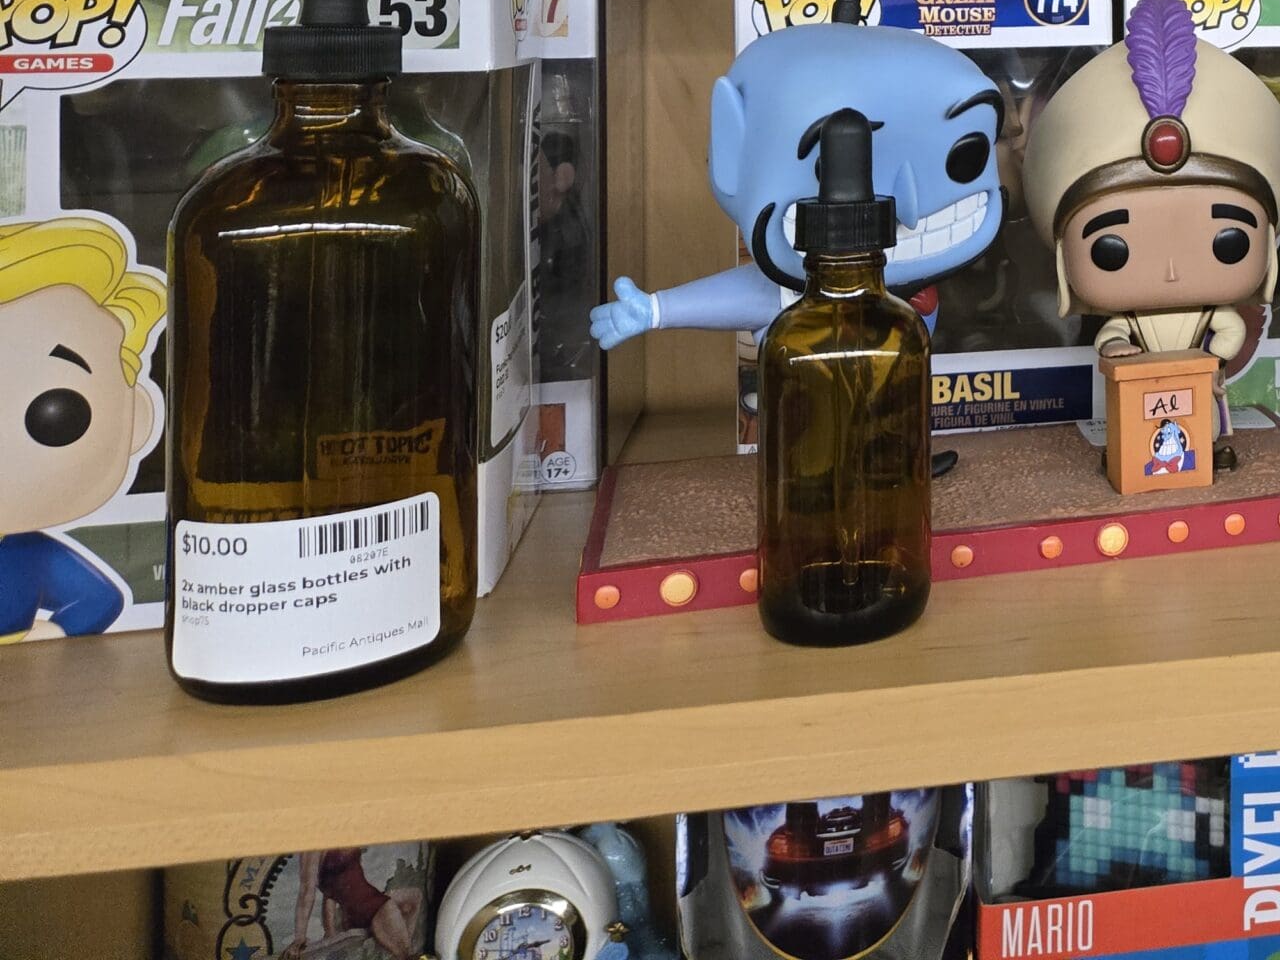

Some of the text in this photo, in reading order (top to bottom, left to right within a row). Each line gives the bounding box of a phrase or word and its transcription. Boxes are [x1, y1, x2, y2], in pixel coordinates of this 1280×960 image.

[918, 5, 998, 25] MOUSE
[924, 24, 991, 41] DETECTIVE
[13, 56, 94, 70] GAMES
[931, 371, 1021, 405] BASIL
[964, 401, 1011, 416] FIGURINE
[1014, 400, 1027, 413] EN
[1030, 397, 1065, 412] VINYLE
[934, 416, 972, 429] FIGURA
[975, 415, 989, 426] DE
[990, 413, 1015, 425] VINIL
[546, 456, 571, 467] AGE
[546, 468, 571, 479] 17+
[182, 530, 249, 557] $10.00
[182, 555, 412, 598] 2x amber glass bottles with
[182, 592, 338, 616] black dropper caps
[302, 616, 430, 657] Pacific Antiques Mall
[518, 906, 532, 919] 12
[483, 918, 564, 944] 10 2
[1002, 899, 1094, 957] MARIO
